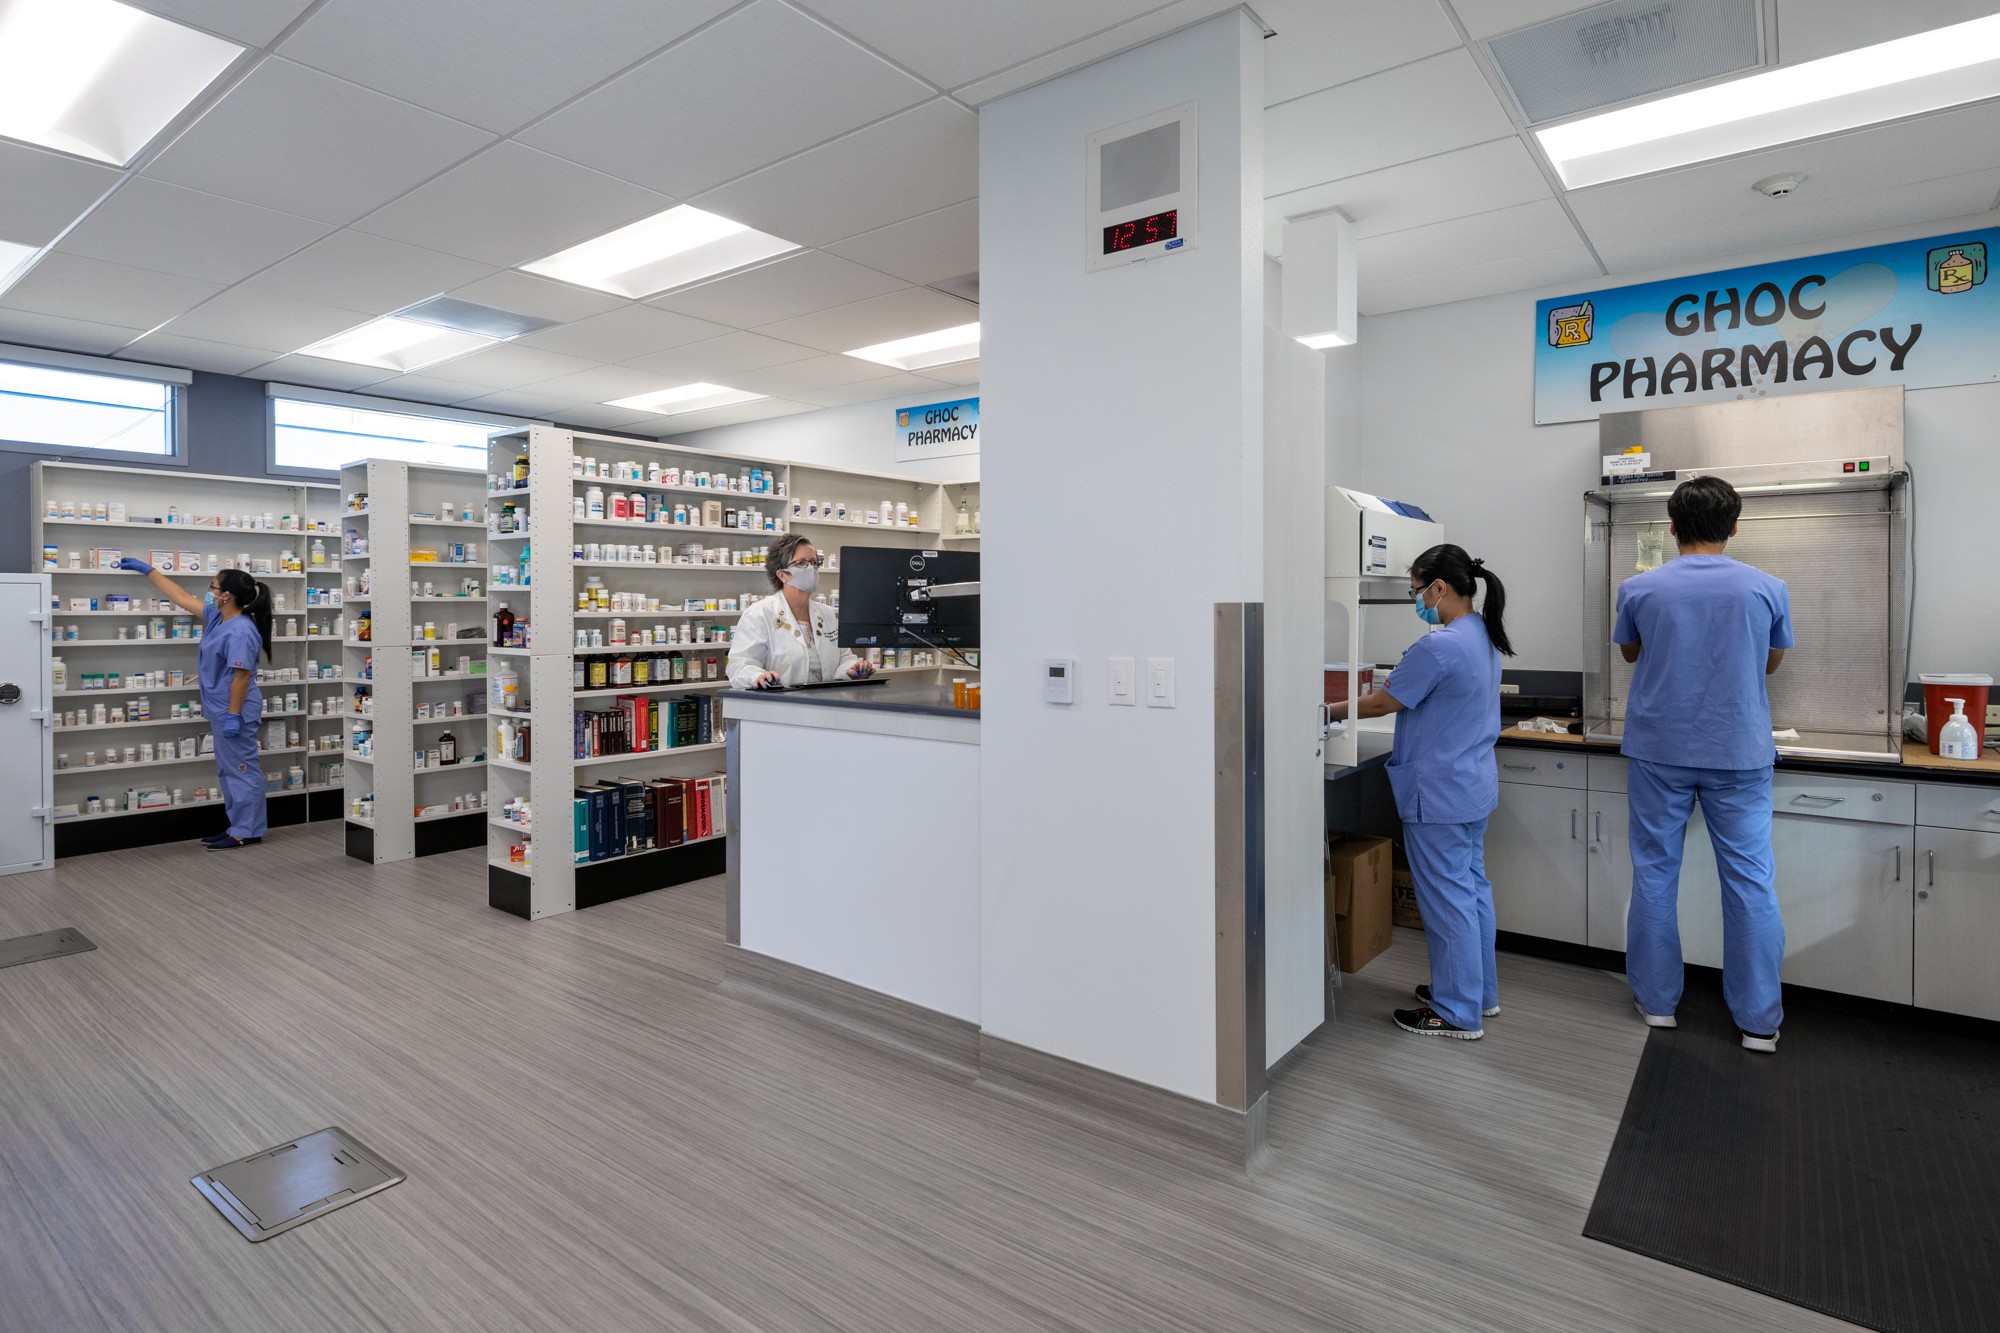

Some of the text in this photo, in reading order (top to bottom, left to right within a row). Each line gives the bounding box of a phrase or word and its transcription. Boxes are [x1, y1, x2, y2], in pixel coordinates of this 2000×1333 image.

[1665, 275, 1828, 337] GHOC
[1590, 323, 1923, 402] PHARMACY
[908, 423, 977, 446] PHARMACY
[925, 406, 959, 425] GHOC
